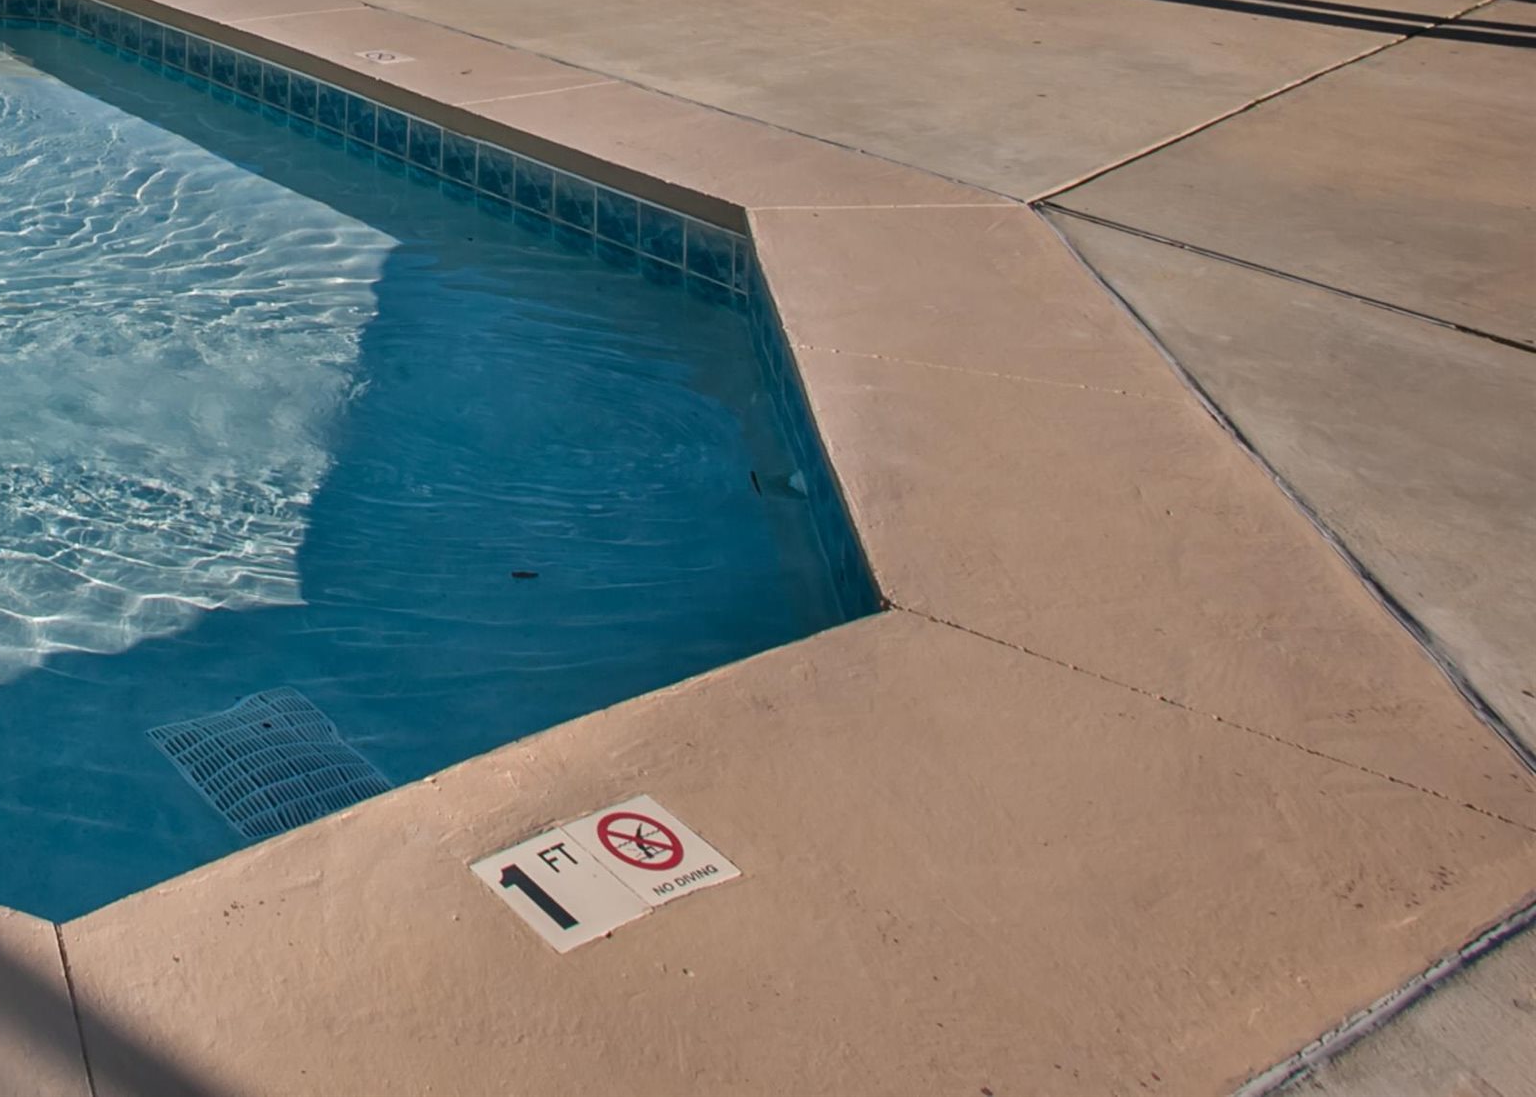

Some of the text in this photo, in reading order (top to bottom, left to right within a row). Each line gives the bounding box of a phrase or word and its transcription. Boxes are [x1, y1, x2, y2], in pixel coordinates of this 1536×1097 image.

[499, 842, 579, 930] 1 FT
[652, 864, 718, 896] NO DIVING
